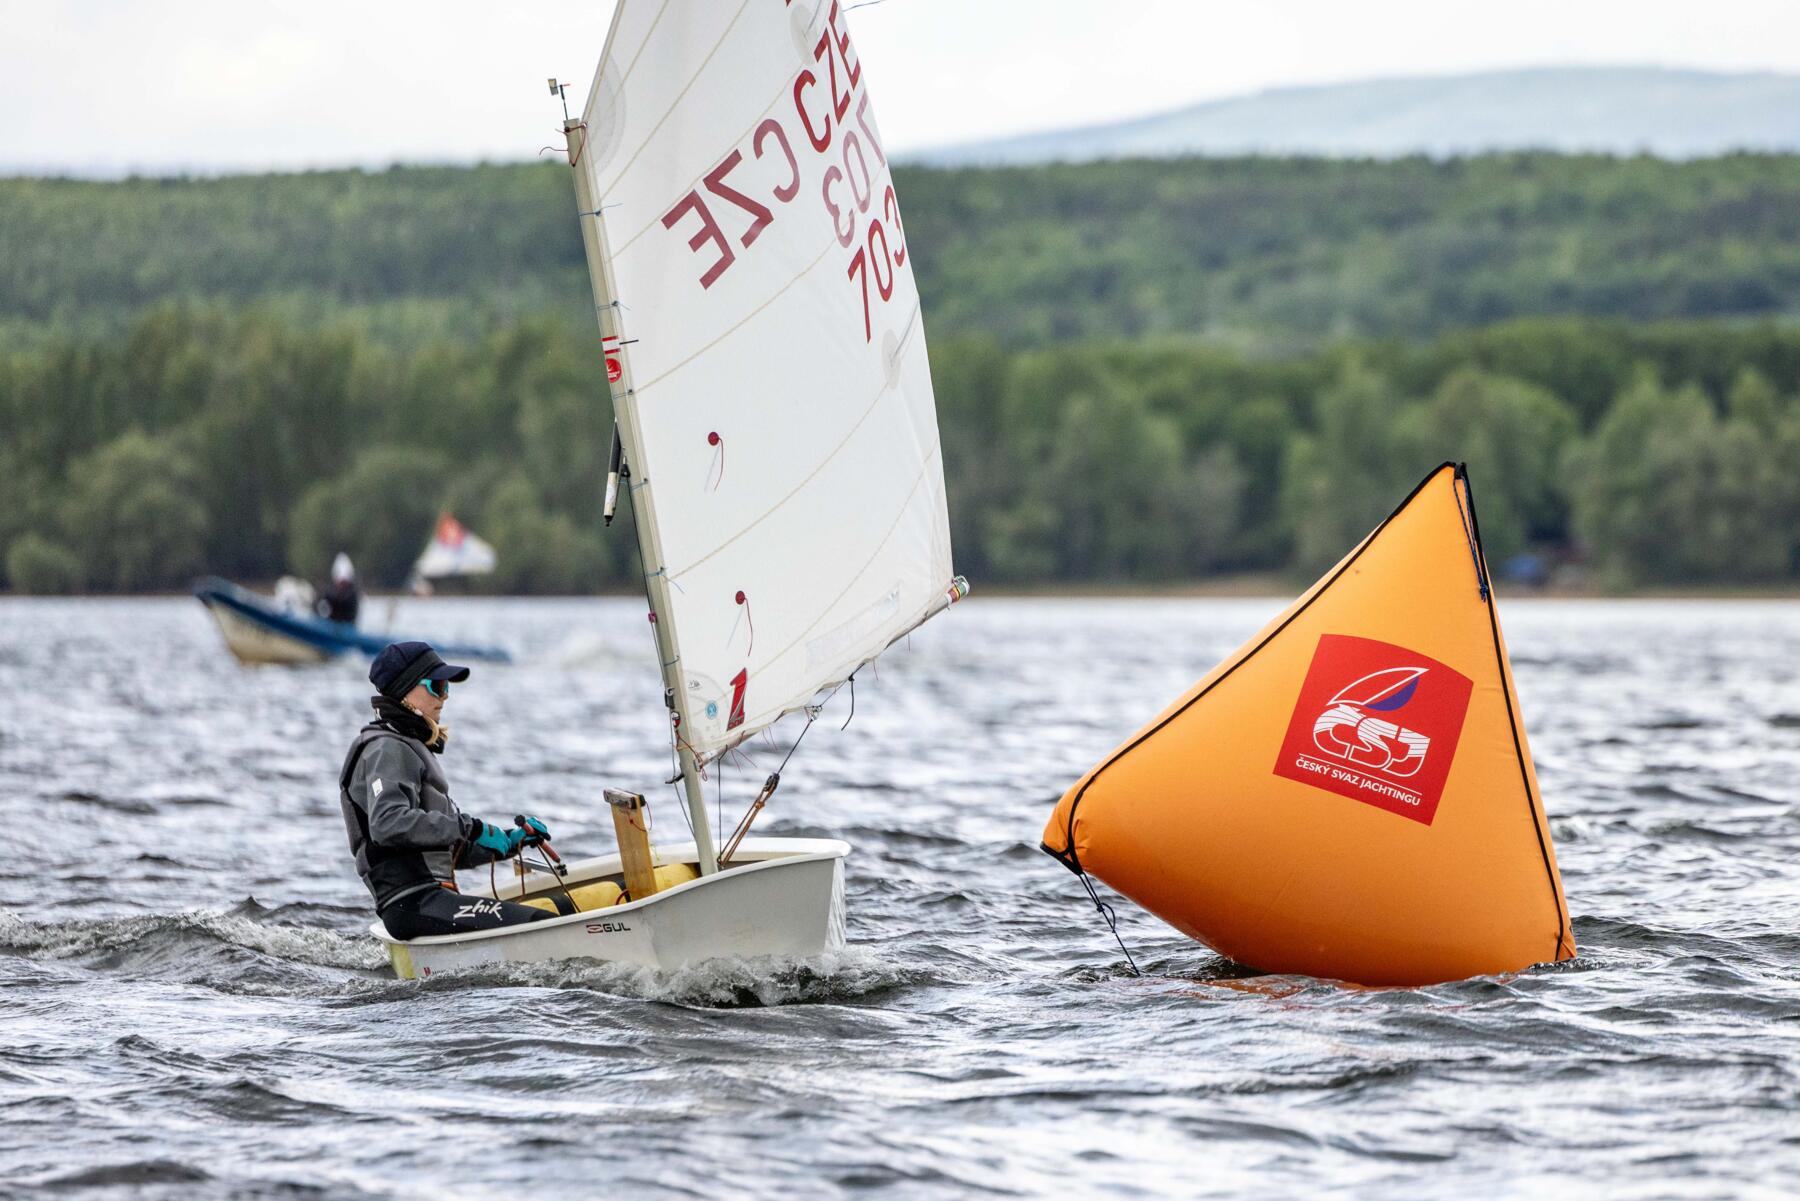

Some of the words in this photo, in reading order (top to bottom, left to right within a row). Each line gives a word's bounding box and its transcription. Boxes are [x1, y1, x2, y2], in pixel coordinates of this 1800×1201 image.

[793, 0, 861, 154] CZE
[847, 185, 906, 344] 703
[1295, 757, 1331, 775] ČESKÝ
[1331, 769, 1360, 785] SVAZ
[1359, 778, 1421, 806] JACHTINGU
[602, 922, 631, 933] GUL
